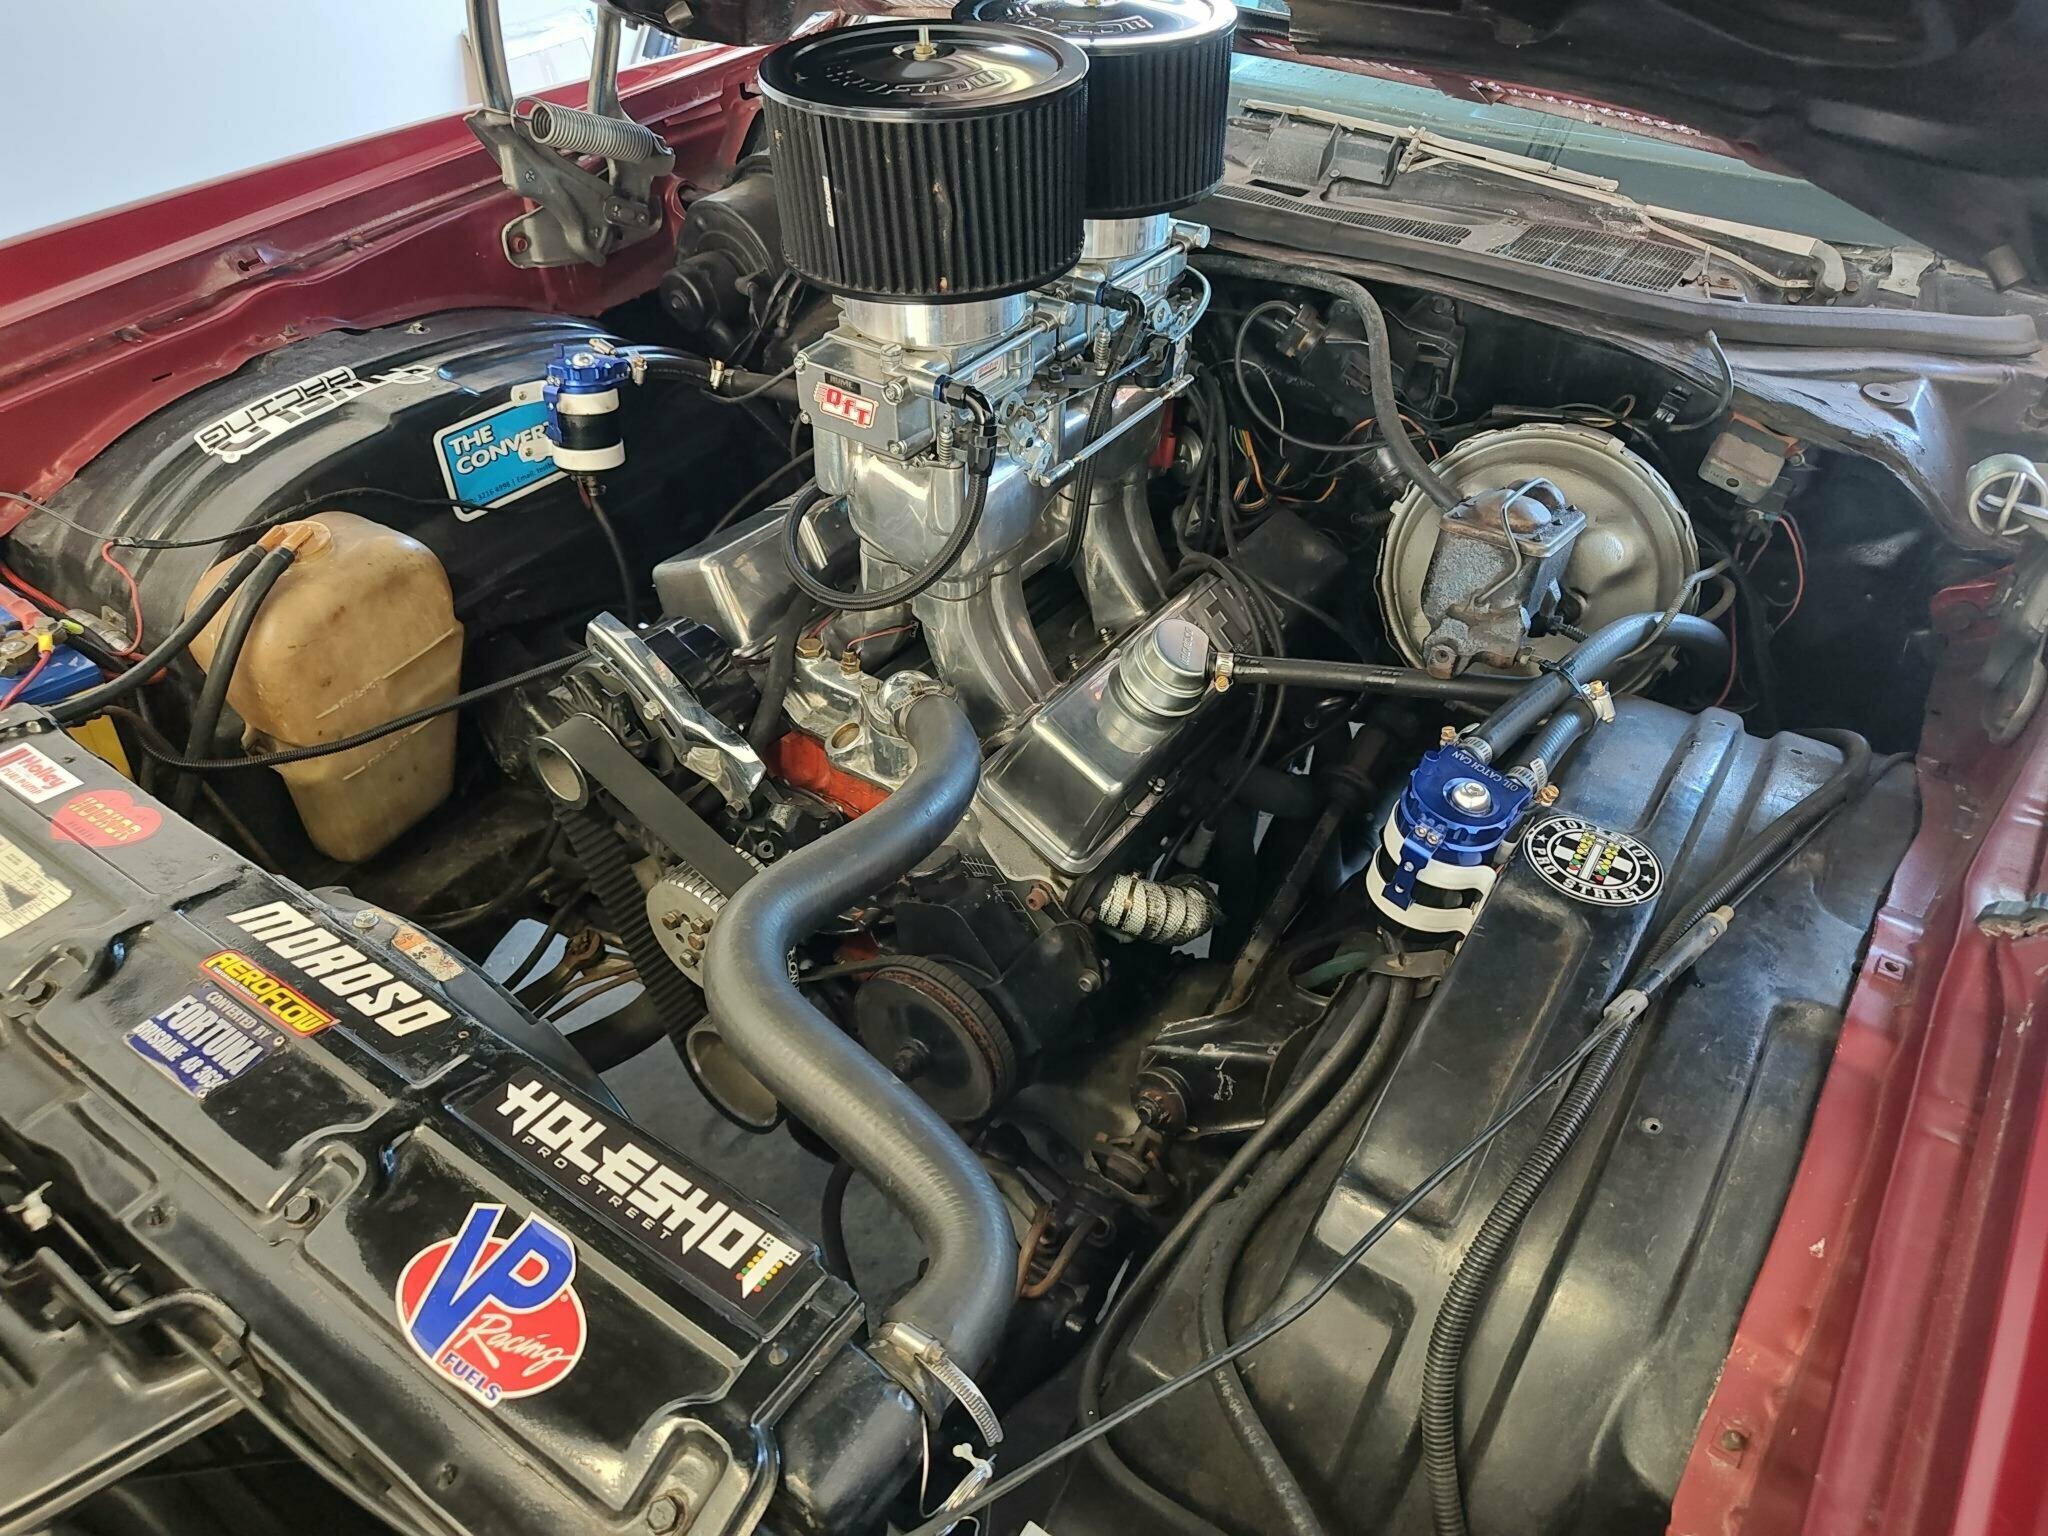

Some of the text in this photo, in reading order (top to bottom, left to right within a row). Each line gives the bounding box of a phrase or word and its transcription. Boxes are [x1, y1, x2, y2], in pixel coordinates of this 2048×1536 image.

[199, 368, 354, 449] RACING
[448, 424, 494, 456] THE
[456, 421, 550, 474] CONVER
[18, 754, 67, 790] Holley
[1452, 750, 1519, 792] OIL CATCH CAN
[68, 796, 142, 842] HOOKER
[1550, 820, 1655, 868] HOLSHOT
[1533, 846, 1645, 900] PRO STREET
[204, 952, 333, 1033] AEROFLOW
[226, 900, 452, 1037] MOROSO
[156, 993, 264, 1076] FORTUNA
[205, 991, 273, 1041] CONVERTED BY
[132, 1019, 190, 1062] BRISBANE
[179, 1055, 205, 1075] 48
[495, 1079, 802, 1300] HOLESHOT
[521, 1135, 673, 1241] PRO STREET
[409, 1203, 575, 1361] VP
[453, 1312, 576, 1378] Racing
[441, 1351, 502, 1402] FUELS
